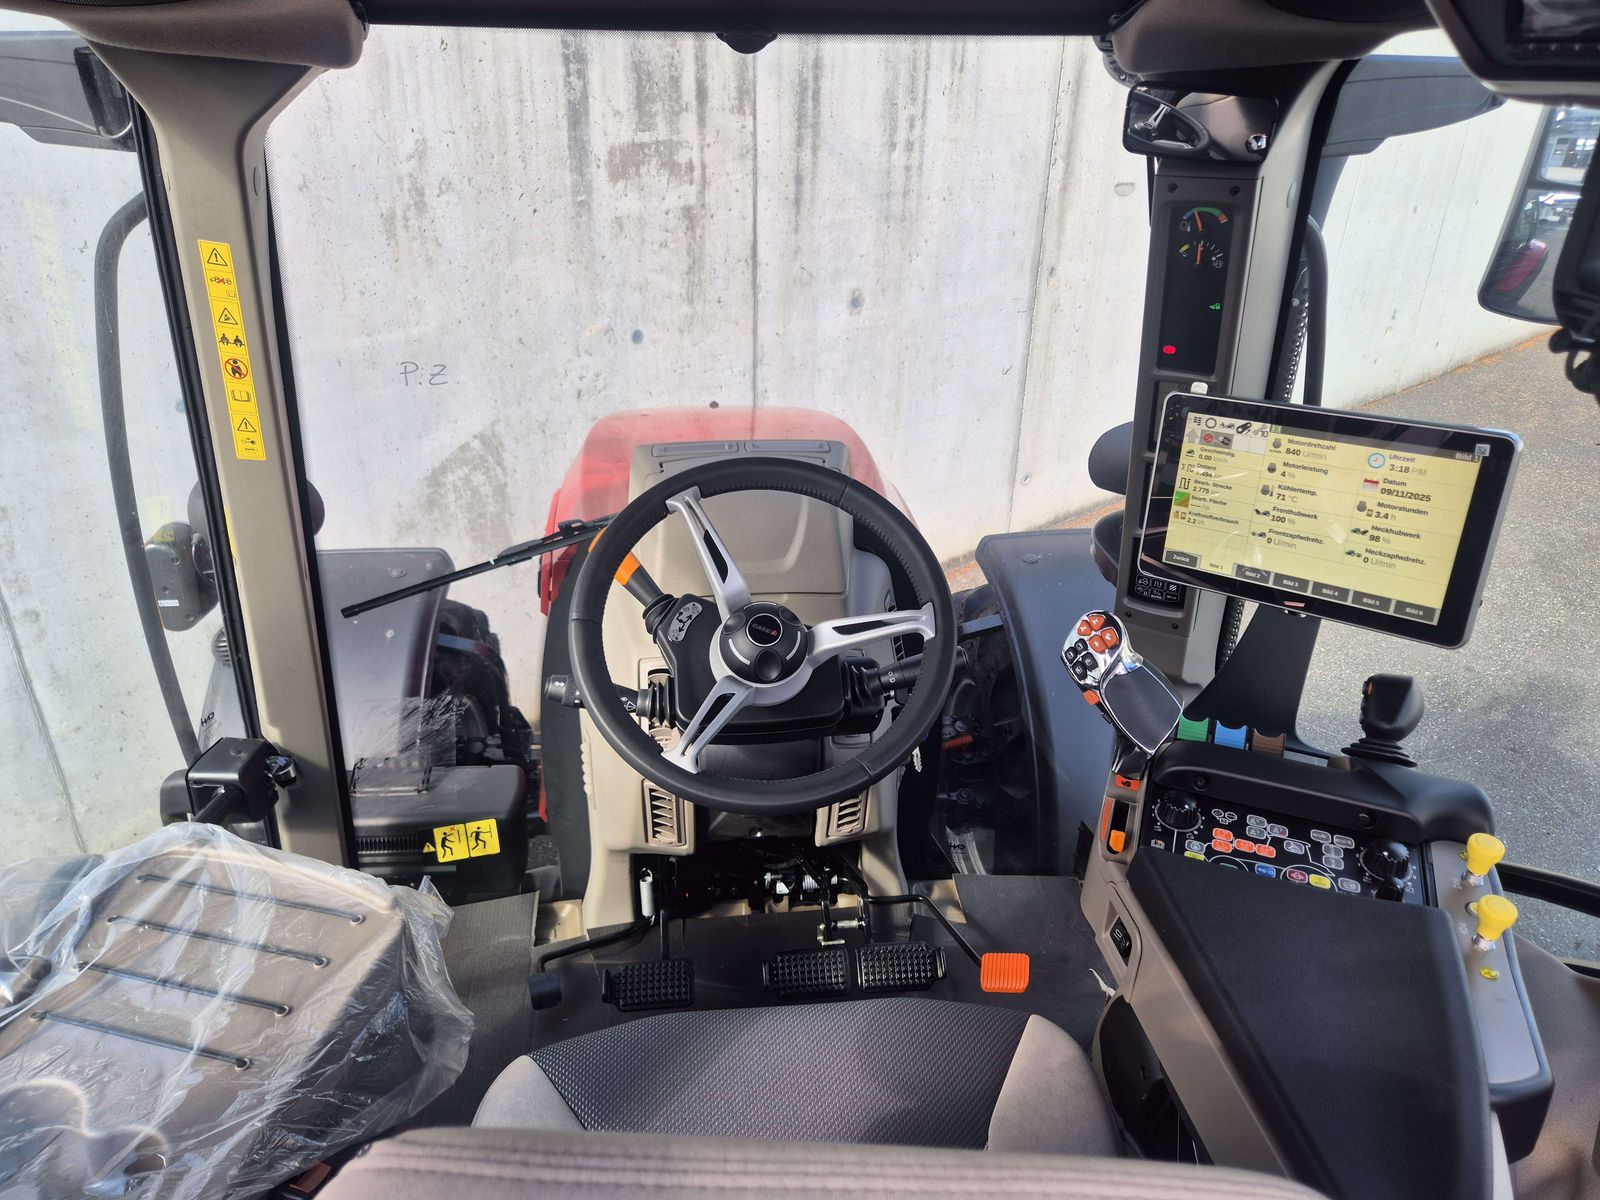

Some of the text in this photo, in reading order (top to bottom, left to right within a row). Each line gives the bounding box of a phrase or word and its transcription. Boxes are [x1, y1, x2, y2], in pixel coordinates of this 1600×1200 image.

[1288, 438, 1336, 451] Motordrehzahl
[1286, 448, 1301, 456] 840
[1389, 454, 1416, 463] Uhrzeit
[1283, 462, 1328, 475] Motorleistung
[1389, 464, 1410, 474] 3:18
[1383, 478, 1407, 487] Datum
[1193, 486, 1210, 494] 2.775
[1278, 484, 1318, 496] Kühlertemp.
[1381, 487, 1432, 502] 09/11/2025
[1272, 506, 1318, 520] Fronthubwerk
[1377, 501, 1428, 516] Motorstunden
[1270, 516, 1286, 524] 100
[1374, 511, 1388, 520] 3.4
[1372, 525, 1421, 540] Heckhubwerk
[1369, 534, 1380, 542] 98
